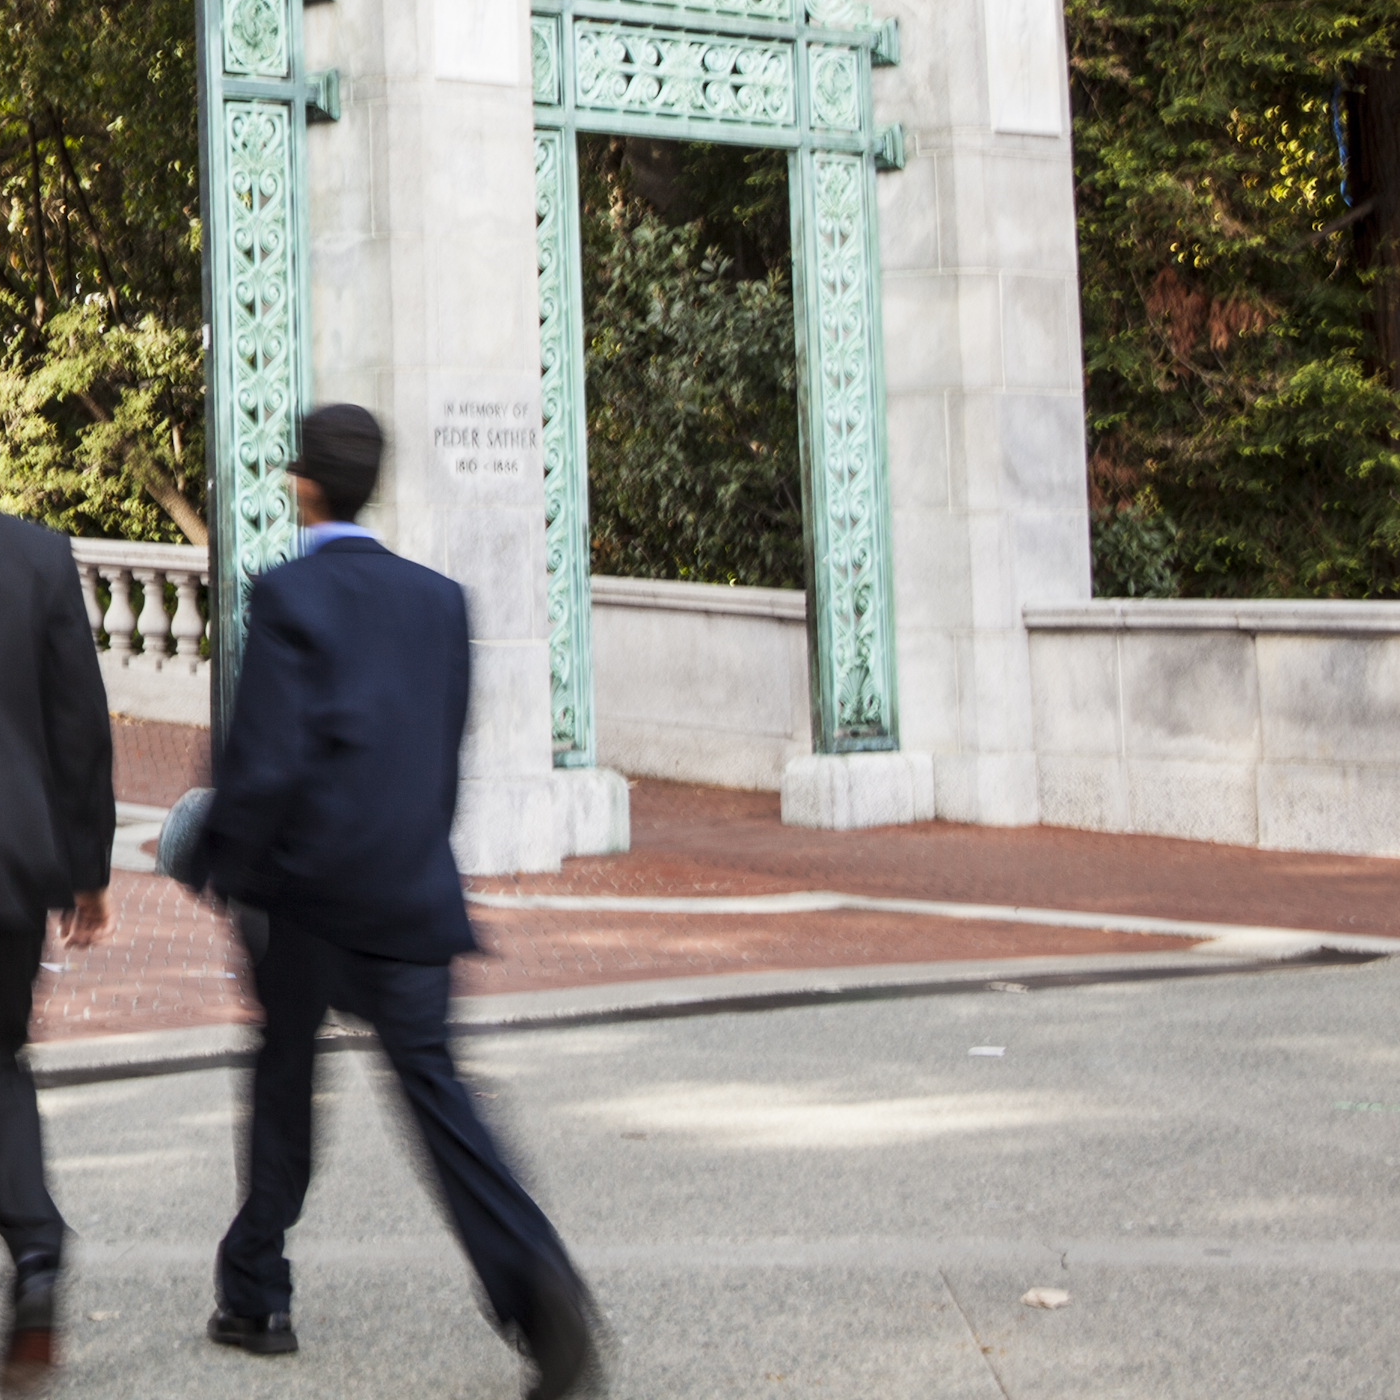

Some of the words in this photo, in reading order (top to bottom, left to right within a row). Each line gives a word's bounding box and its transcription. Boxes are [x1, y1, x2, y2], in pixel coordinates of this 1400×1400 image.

[443, 401, 455, 417] IN
[459, 400, 509, 419] MEMORY
[512, 401, 529, 419] OF
[434, 425, 480, 450] PEDER
[486, 426, 538, 450] SATHER
